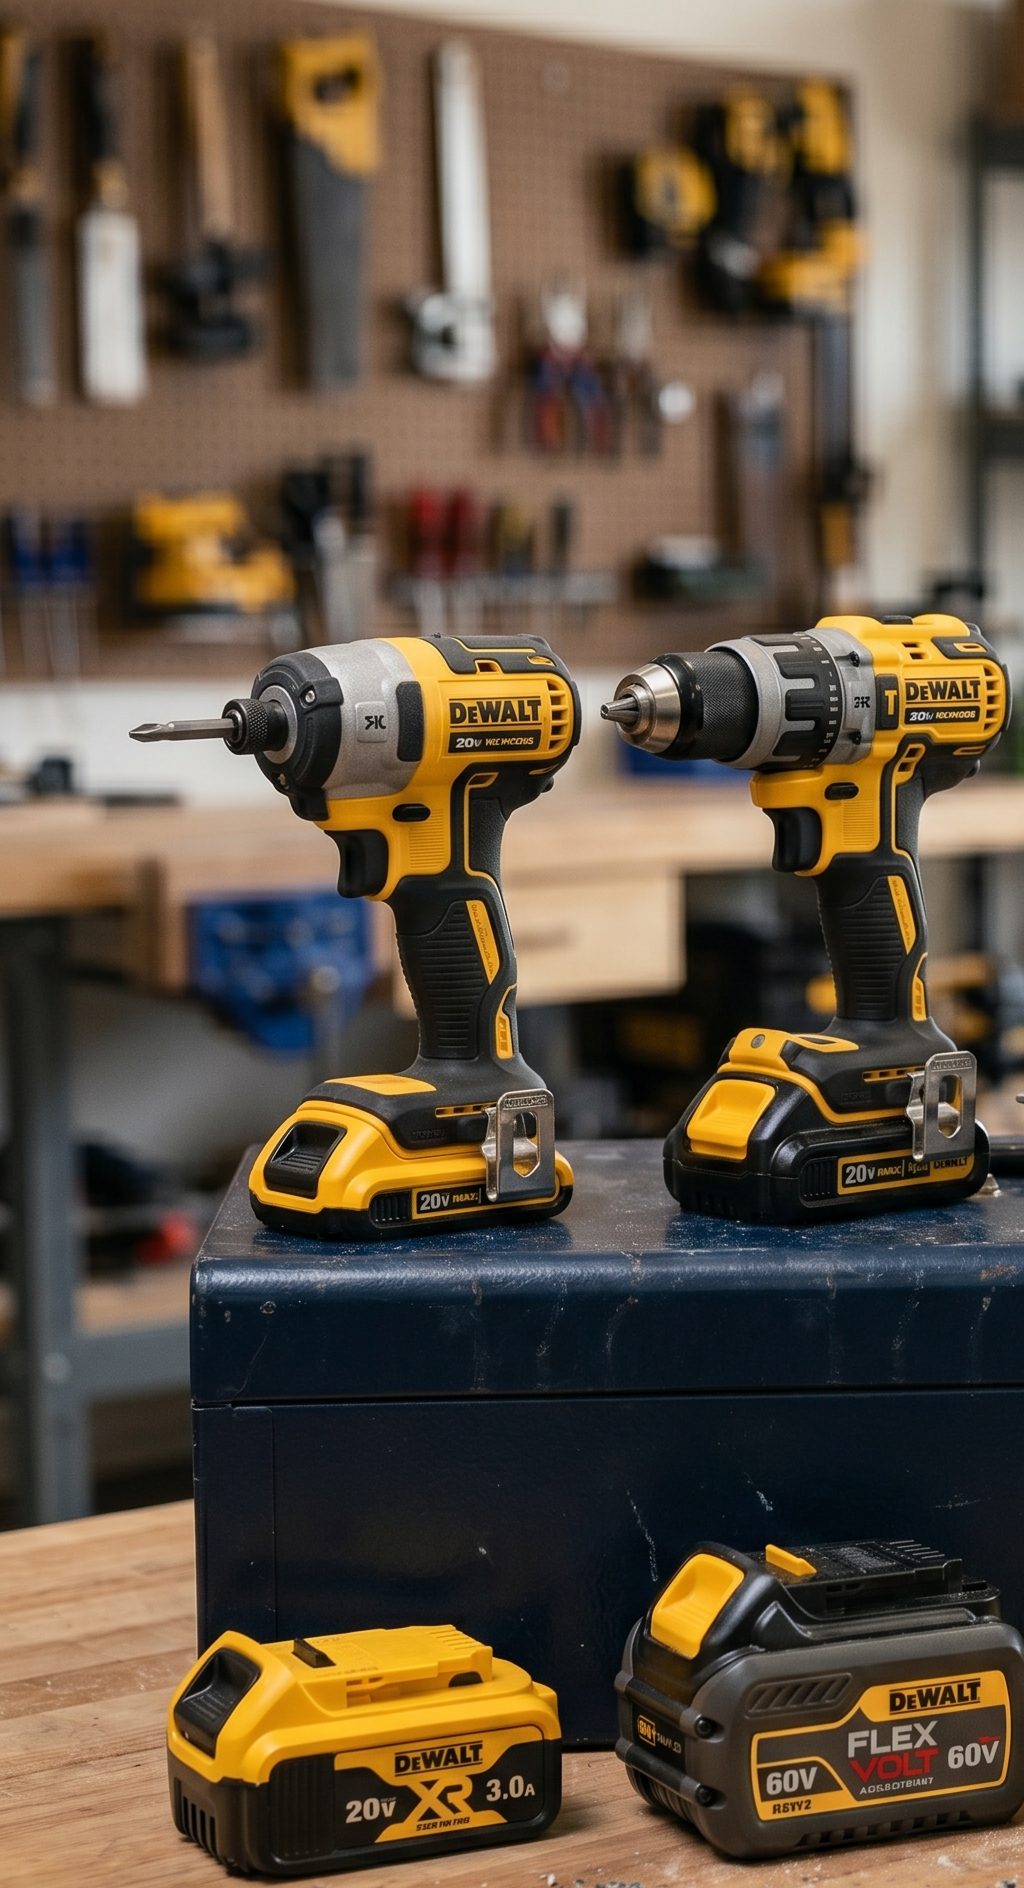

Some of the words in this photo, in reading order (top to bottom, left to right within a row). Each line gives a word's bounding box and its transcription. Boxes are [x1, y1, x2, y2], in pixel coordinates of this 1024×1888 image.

[844, 1163, 876, 1184] 20V
[420, 1193, 450, 1211] 20V
[848, 1720, 938, 1758] FLEX
[850, 1748, 939, 1783] VOLT
[948, 1740, 1000, 1769] 60V
[766, 1767, 818, 1796] 60V
[345, 1797, 397, 1824] 20V
